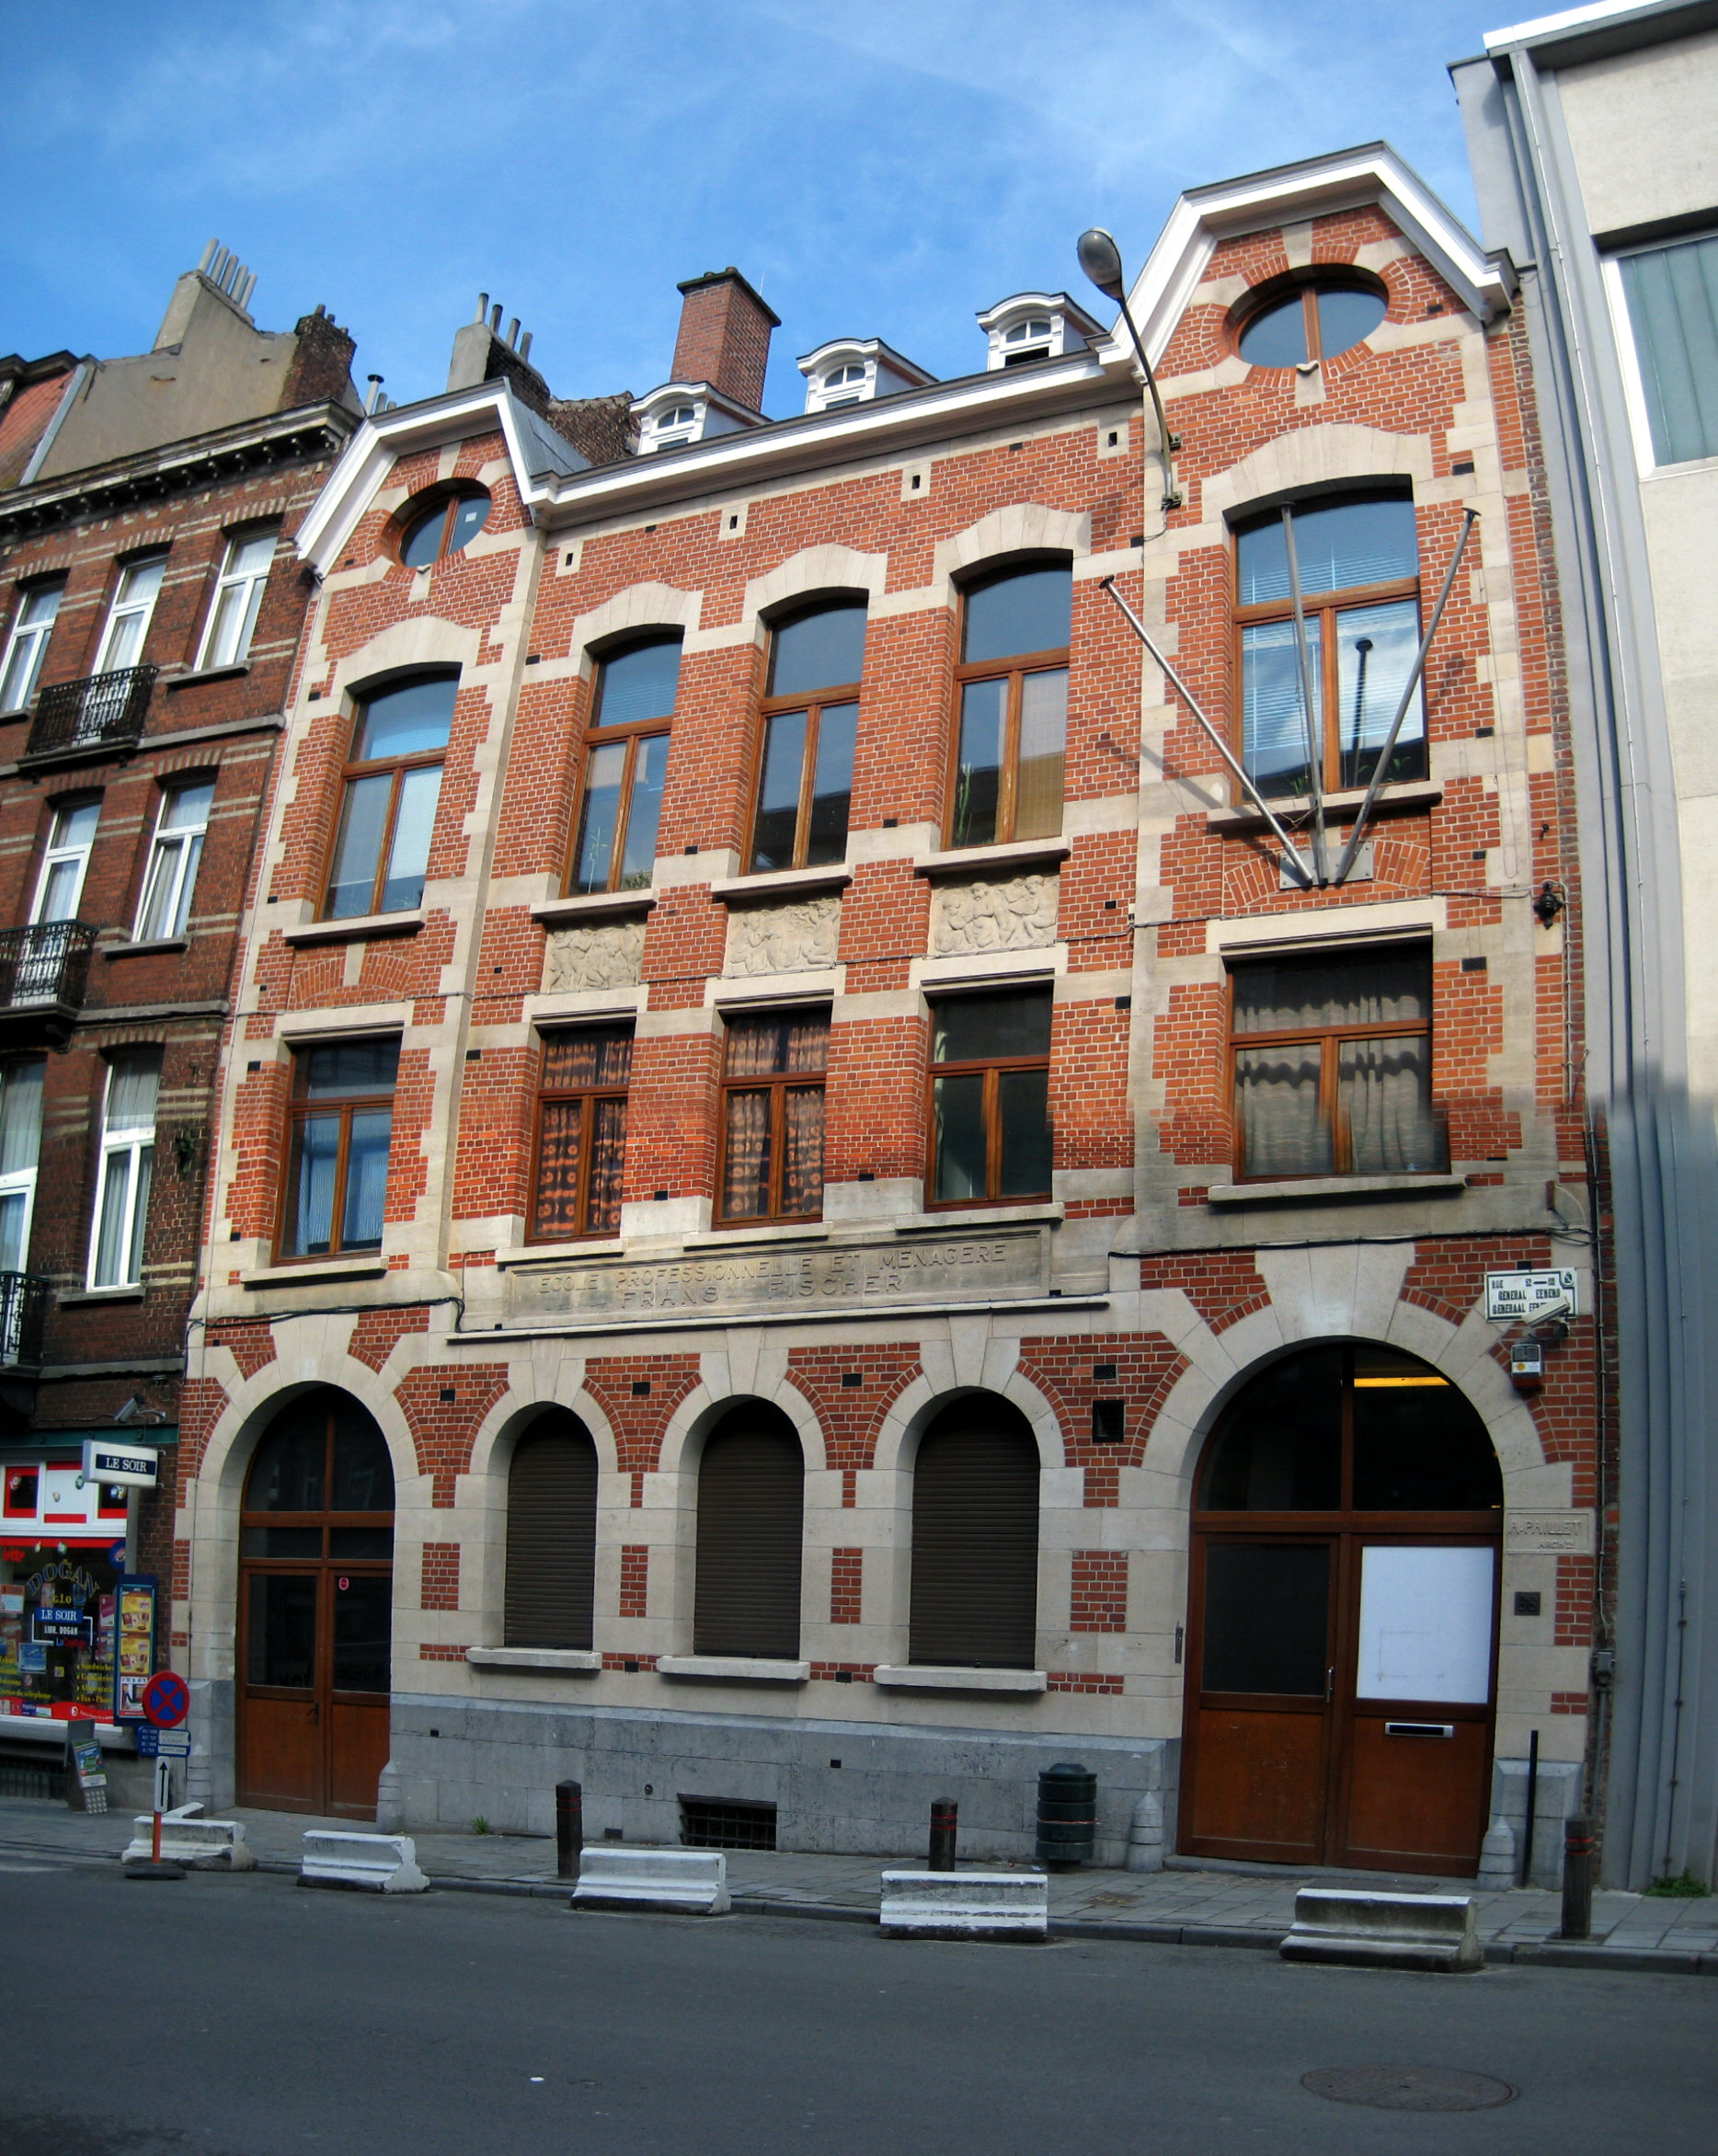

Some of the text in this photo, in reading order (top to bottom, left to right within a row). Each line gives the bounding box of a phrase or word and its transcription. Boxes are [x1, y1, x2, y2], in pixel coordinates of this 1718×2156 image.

[540, 1244, 1006, 1293] ECOLE PROFESSIONNELLE ET MENAGERE
[1492, 1279, 1504, 1290] RUE
[622, 1275, 901, 1309] FRANS FISCHER
[1498, 1288, 1561, 1302] GENERAL EENENS
[1492, 1302, 1527, 1314] GENERAAL
[106, 1457, 147, 1473] LE SOIR
[41, 1610, 77, 1621] LE SOIR
